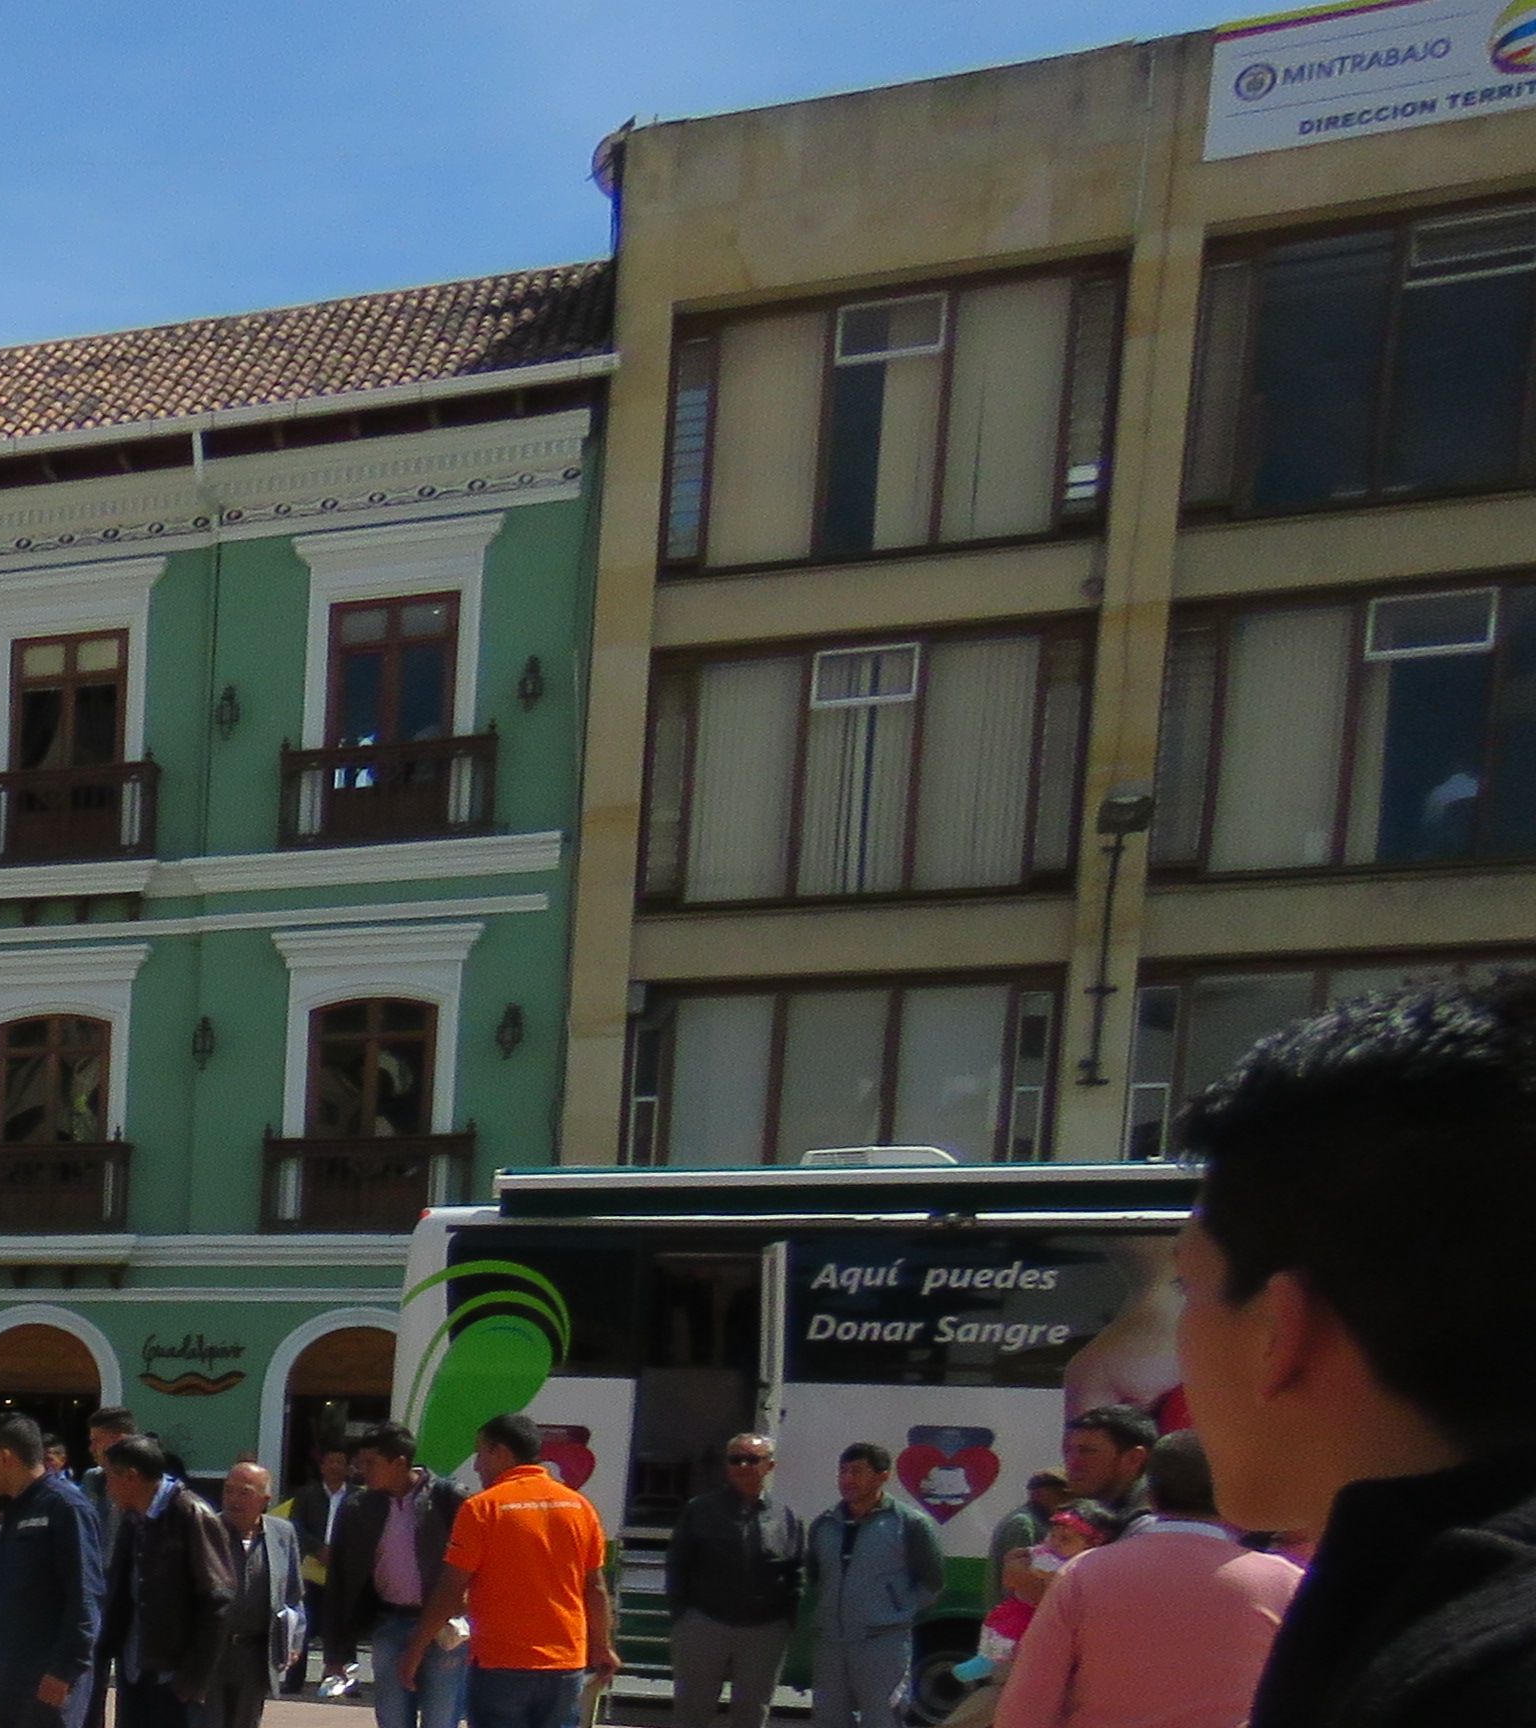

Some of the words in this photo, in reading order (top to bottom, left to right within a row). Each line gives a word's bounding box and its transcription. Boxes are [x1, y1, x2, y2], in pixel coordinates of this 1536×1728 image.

[1282, 36, 1452, 87] MINTRABAJO
[1298, 98, 1436, 136] DIRECCION
[810, 1257, 906, 1295] Aquí
[921, 1260, 1059, 1296] puedes
[806, 1314, 925, 1342] Donar
[933, 1315, 1070, 1351] Sangre
